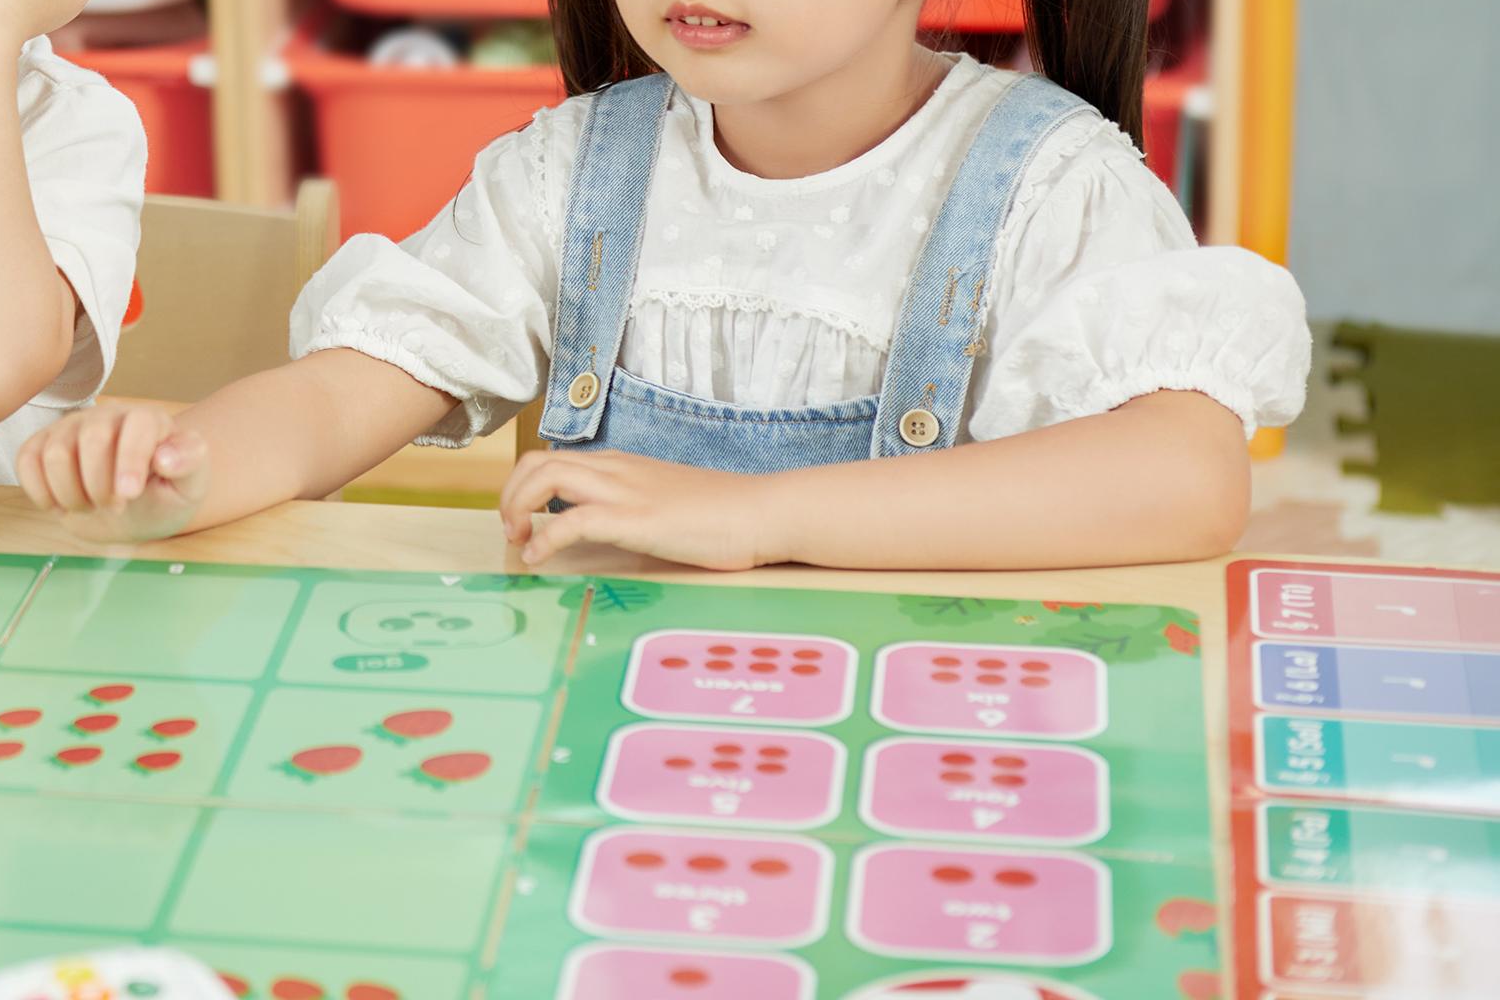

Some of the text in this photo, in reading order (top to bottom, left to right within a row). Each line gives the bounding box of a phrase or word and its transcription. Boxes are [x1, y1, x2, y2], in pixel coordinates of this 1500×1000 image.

[692, 678, 784, 692] seven
[730, 696, 756, 714] 7
[966, 692, 1010, 706] six
[975, 709, 1007, 728] 6
[688, 775, 753, 793] five
[710, 792, 740, 815] 5
[947, 789, 1020, 807] four
[971, 807, 1004, 829] 4
[687, 904, 720, 931] 3
[943, 899, 1012, 921] two
[966, 921, 999, 950] 2
